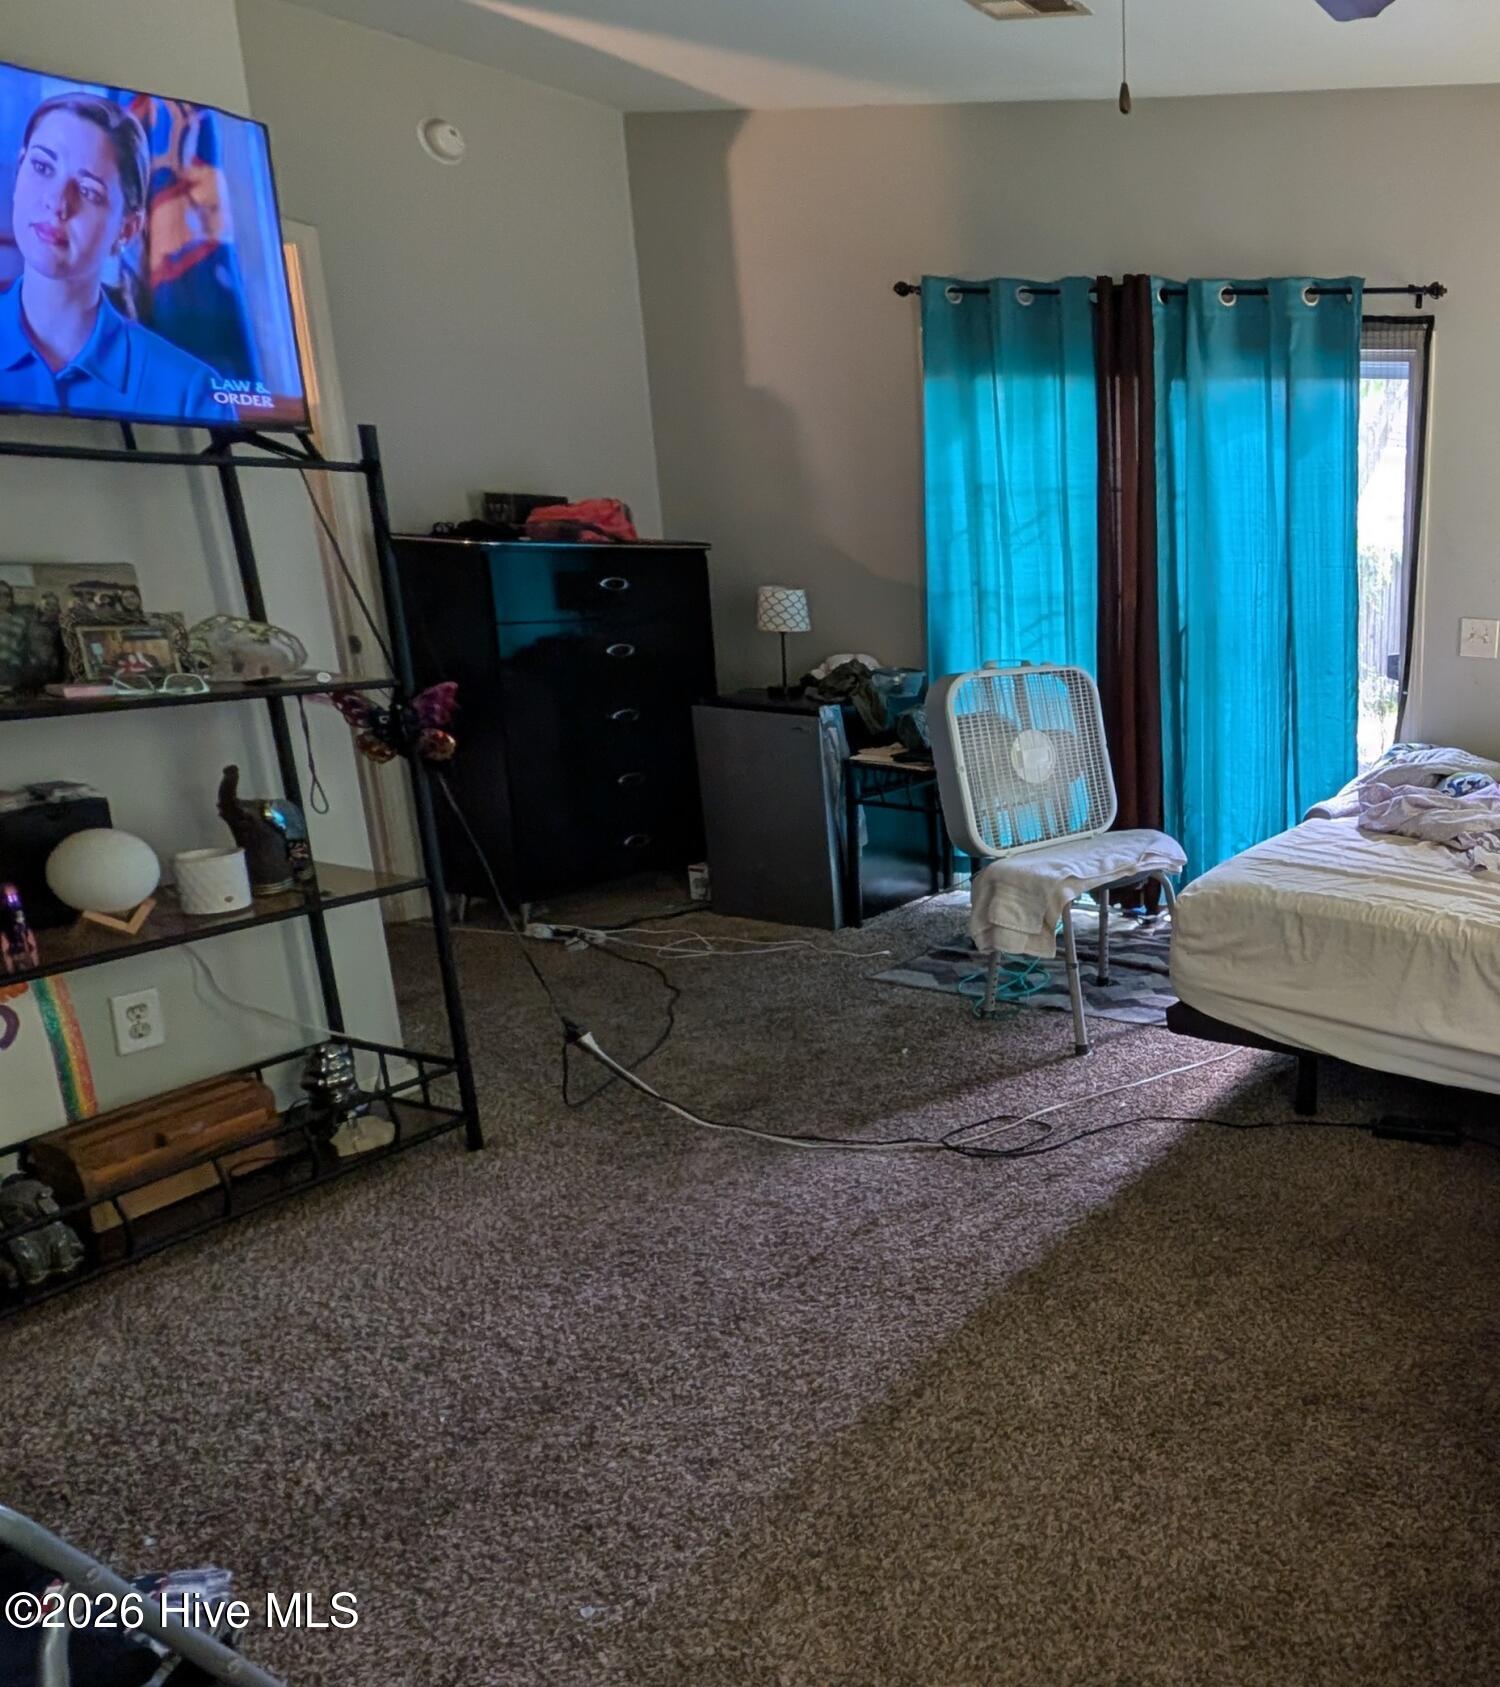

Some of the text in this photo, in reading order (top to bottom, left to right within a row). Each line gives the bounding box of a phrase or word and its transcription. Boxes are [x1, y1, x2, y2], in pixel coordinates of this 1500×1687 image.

[210, 377, 272, 394] LAW &
[213, 391, 275, 408] ORDER
